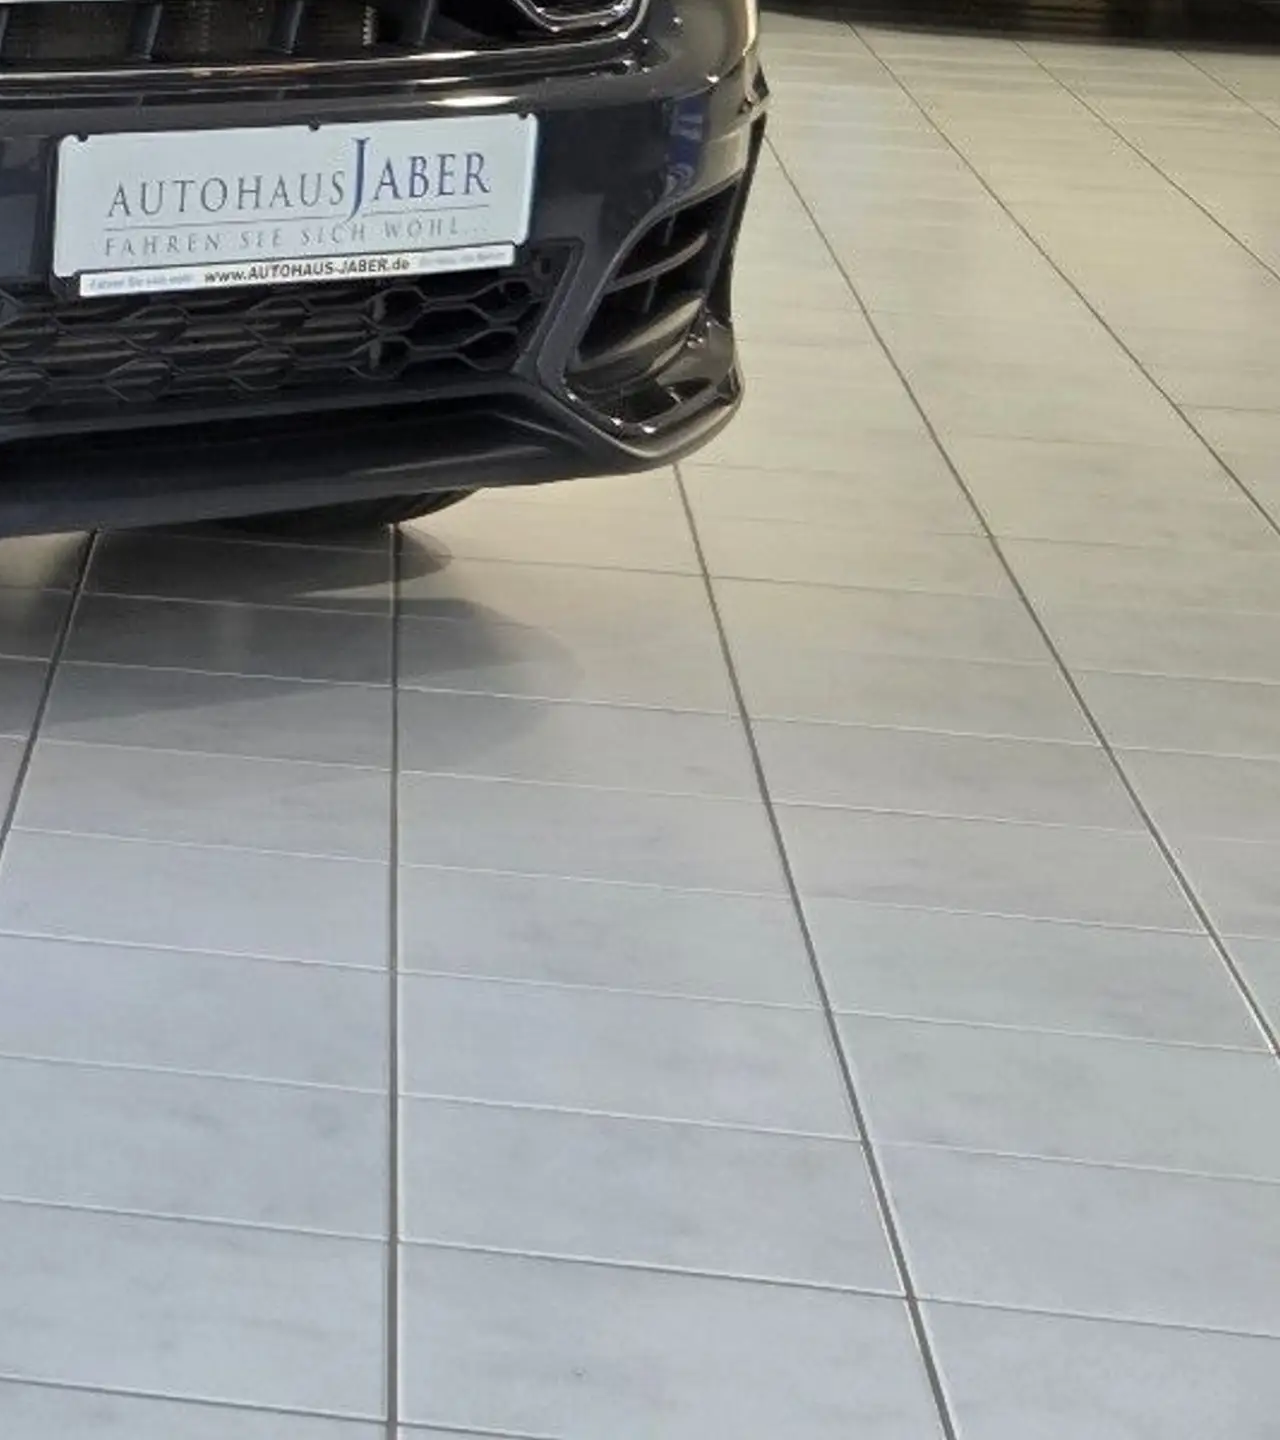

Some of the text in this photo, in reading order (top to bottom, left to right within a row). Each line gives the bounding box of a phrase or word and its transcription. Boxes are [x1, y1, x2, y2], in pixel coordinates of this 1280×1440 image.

[107, 137, 491, 222] AUTOHAUS JABER
[104, 233, 220, 257] FAHREN
[241, 229, 283, 249] SIE
[301, 220, 365, 246] SICH
[204, 259, 410, 284] www.AUTOHAUS-JABER.de
